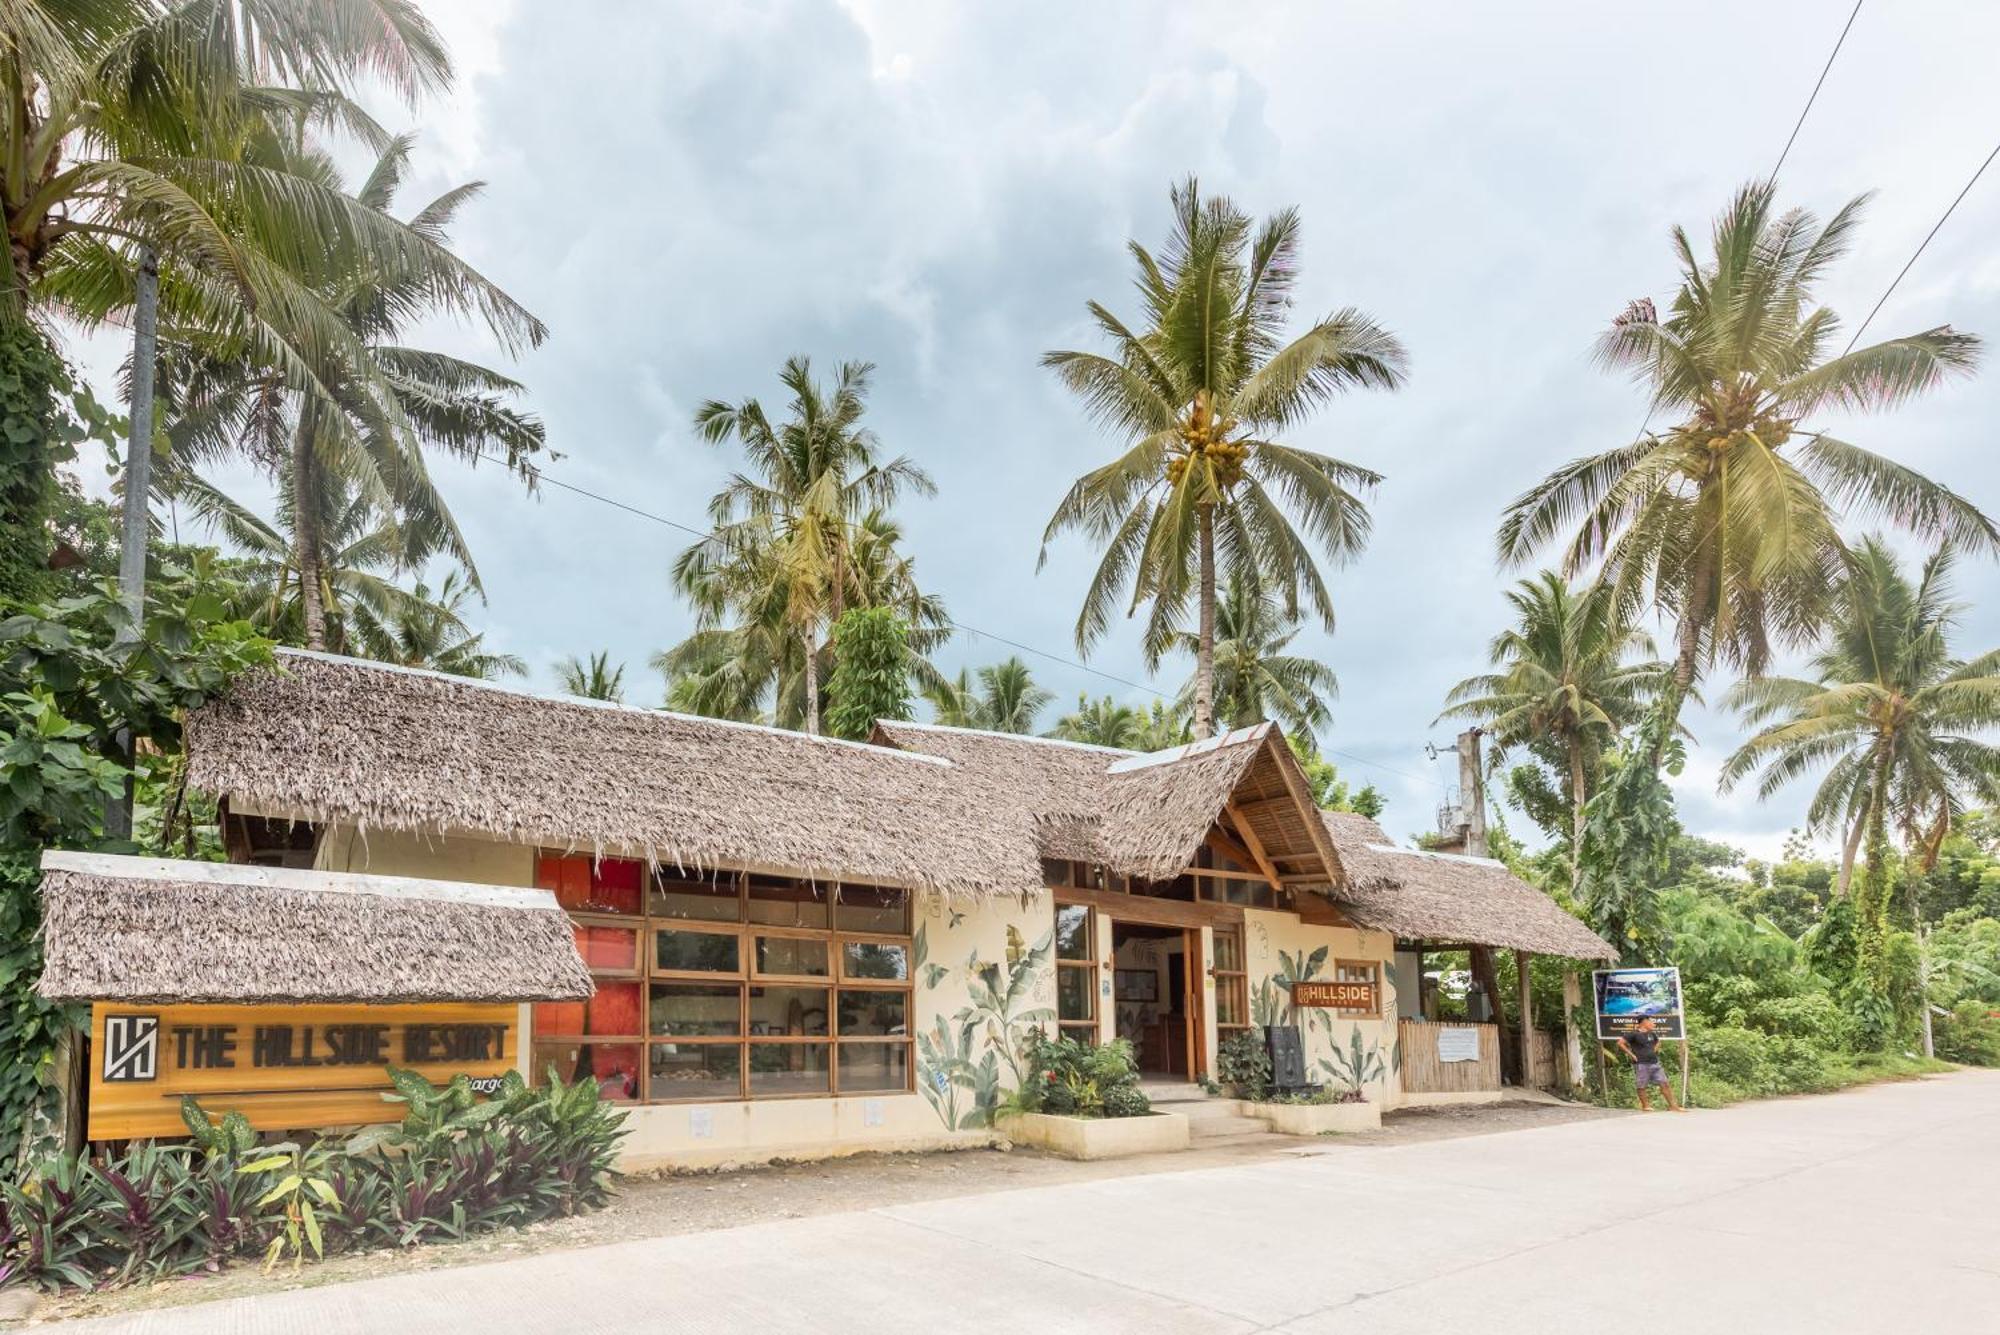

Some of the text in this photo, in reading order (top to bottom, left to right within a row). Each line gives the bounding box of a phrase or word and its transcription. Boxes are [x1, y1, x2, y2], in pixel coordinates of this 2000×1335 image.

[1309, 985, 1369, 1001] HILLSIDE
[172, 1024, 509, 1068] THE HILLSIDE RESORT
